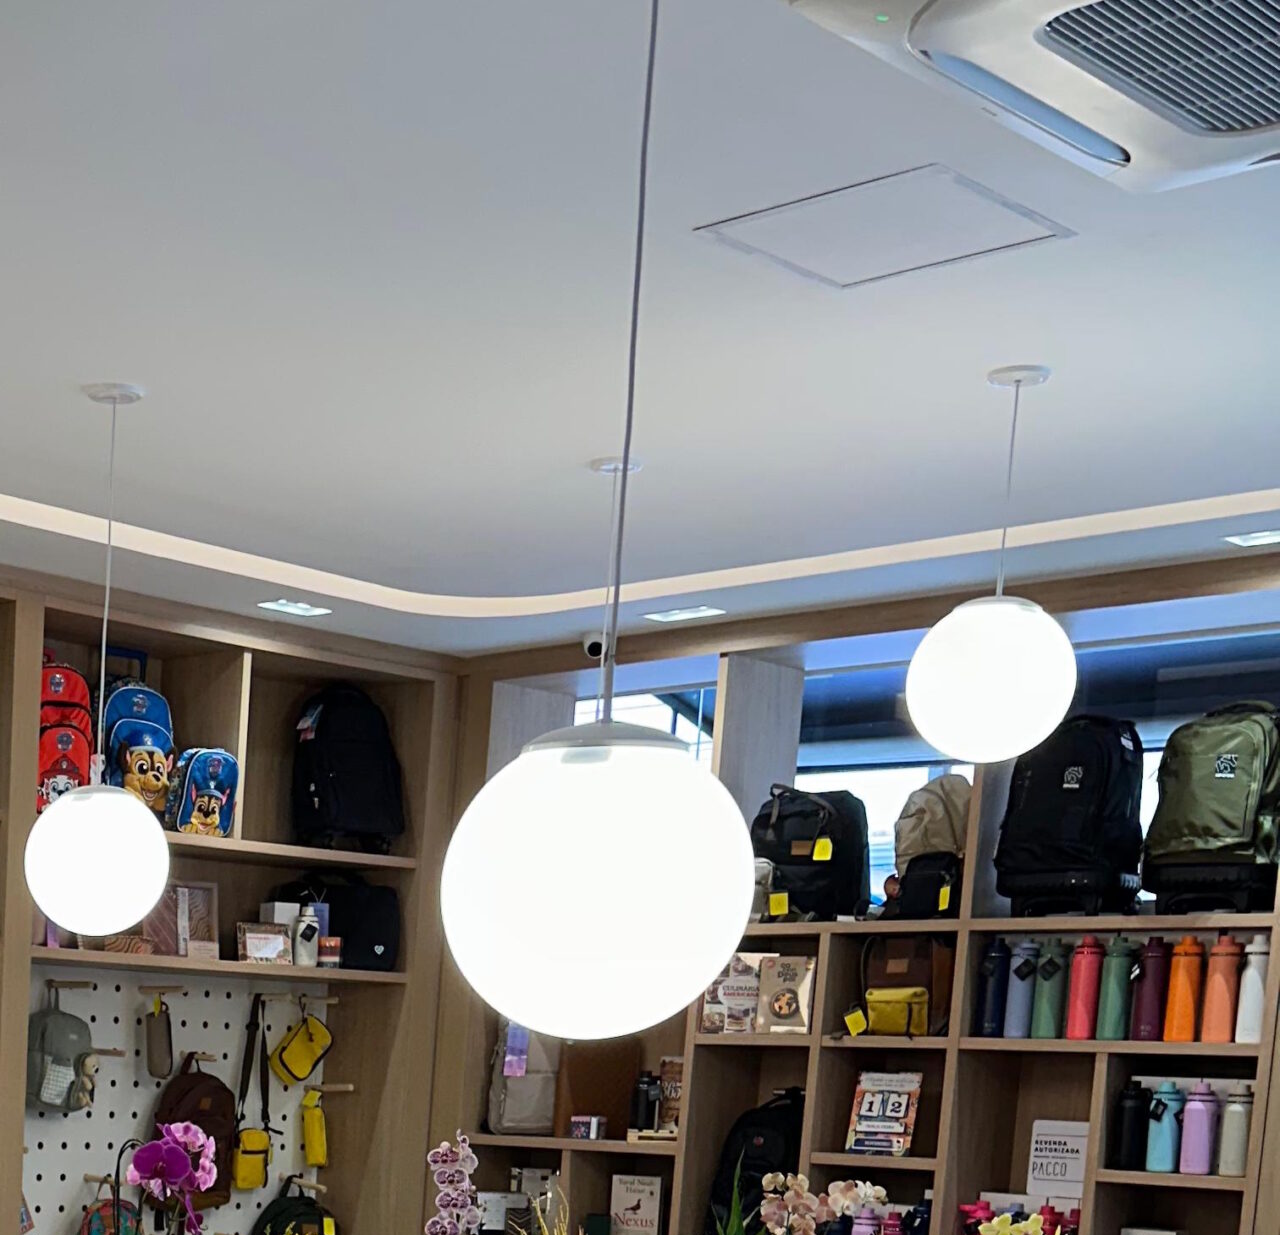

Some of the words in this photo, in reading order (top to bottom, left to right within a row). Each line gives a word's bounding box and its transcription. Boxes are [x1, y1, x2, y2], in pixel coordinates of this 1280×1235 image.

[865, 1100, 874, 1112] 1
[890, 1101, 902, 1113] 2
[1034, 1146, 1080, 1154] AUTORIZADA
[1032, 1161, 1067, 1177] PACCO
[615, 1212, 654, 1228] Nexus
